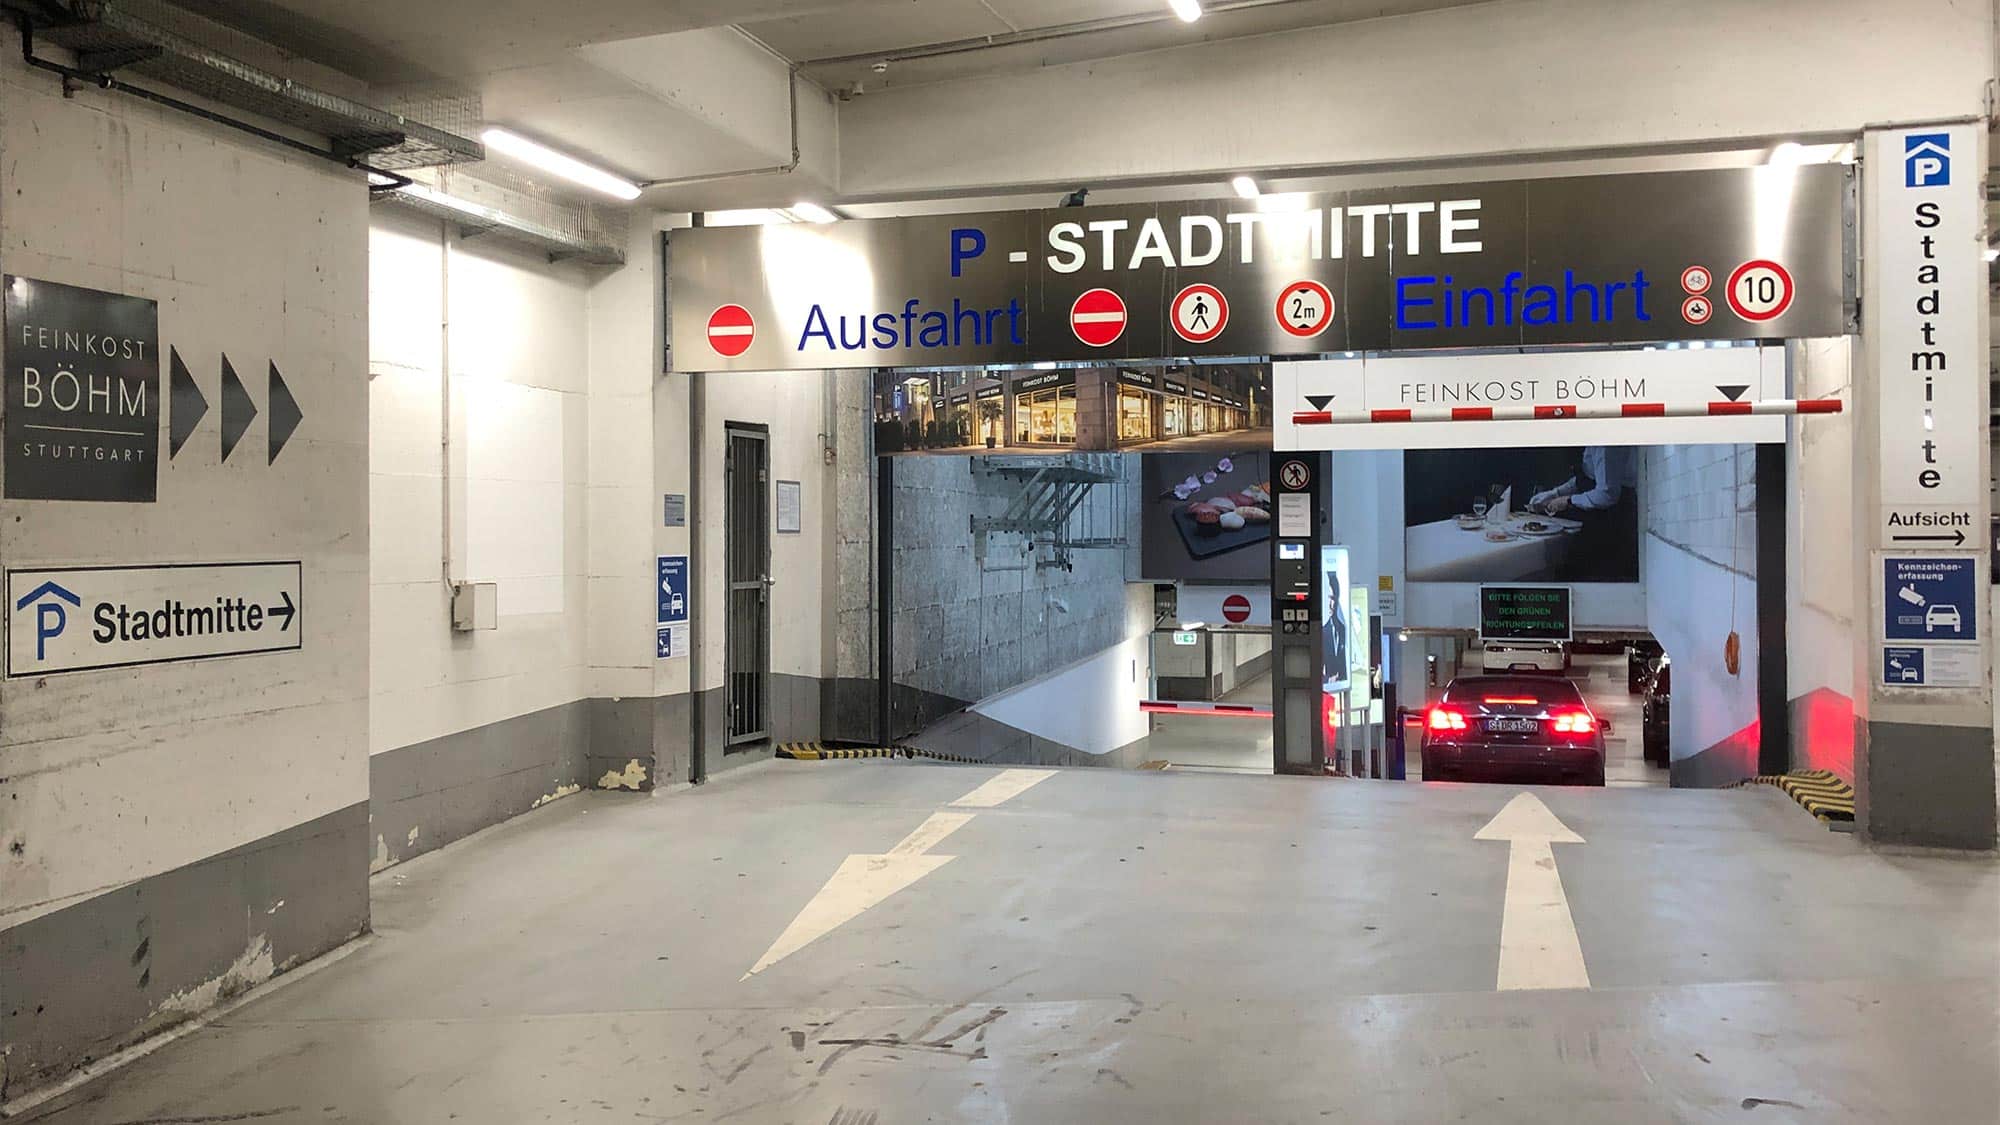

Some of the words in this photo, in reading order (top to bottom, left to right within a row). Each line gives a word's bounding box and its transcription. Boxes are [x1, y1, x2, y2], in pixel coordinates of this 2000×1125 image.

[951, 228, 987, 277] P
[1397, 269, 1651, 330] Einfahrt
[1745, 278, 1775, 304] 10
[798, 298, 1024, 351] Ausfahrt
[23, 325, 145, 360] FEINKOST
[1912, 202, 1946, 489] Stadtmite
[24, 362, 146, 417] BÖHM
[1400, 380, 1538, 403] FEINKOST
[1556, 376, 1648, 400] BÖHM
[24, 443, 144, 462] STUTTGART
[1888, 512, 1970, 526] Aufsicht
[1898, 563, 1962, 571] Kennzeichen-
[1898, 572, 1944, 581] erfassung
[1488, 593, 1512, 601] BITTE
[1513, 593, 1546, 602] FOLGEN
[1498, 607, 1515, 615] DEN
[1516, 606, 1551, 615] GRÜNEN
[37, 602, 66, 661] P
[93, 597, 263, 643] Stadtmitte
[1486, 620, 1564, 629] RICHTUNGSPFEILEN
